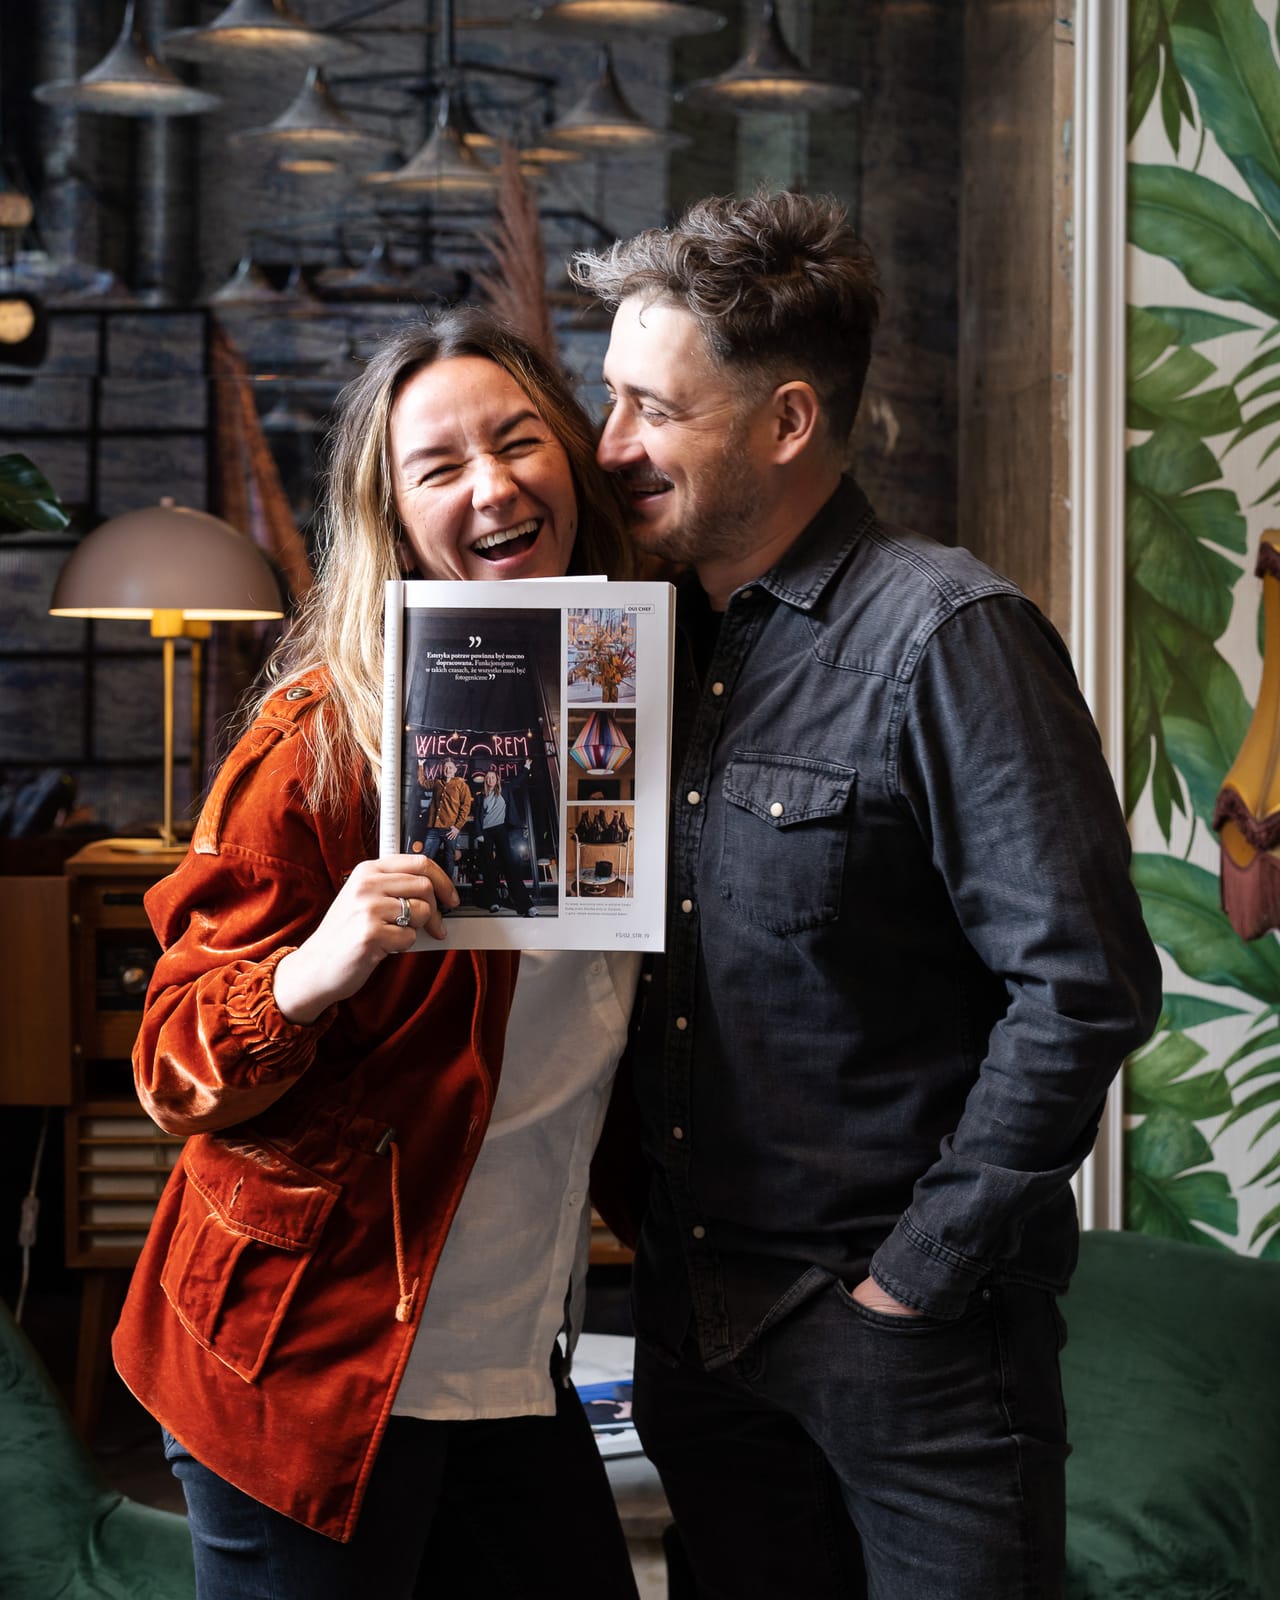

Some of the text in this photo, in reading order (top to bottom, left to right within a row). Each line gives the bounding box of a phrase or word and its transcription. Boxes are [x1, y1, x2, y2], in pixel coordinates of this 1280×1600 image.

[427, 652, 450, 660] Estetyka
[495, 652, 504, 660] być
[436, 659, 514, 668] dopracowana. Funkcjonujemy
[516, 667, 526, 675] być
